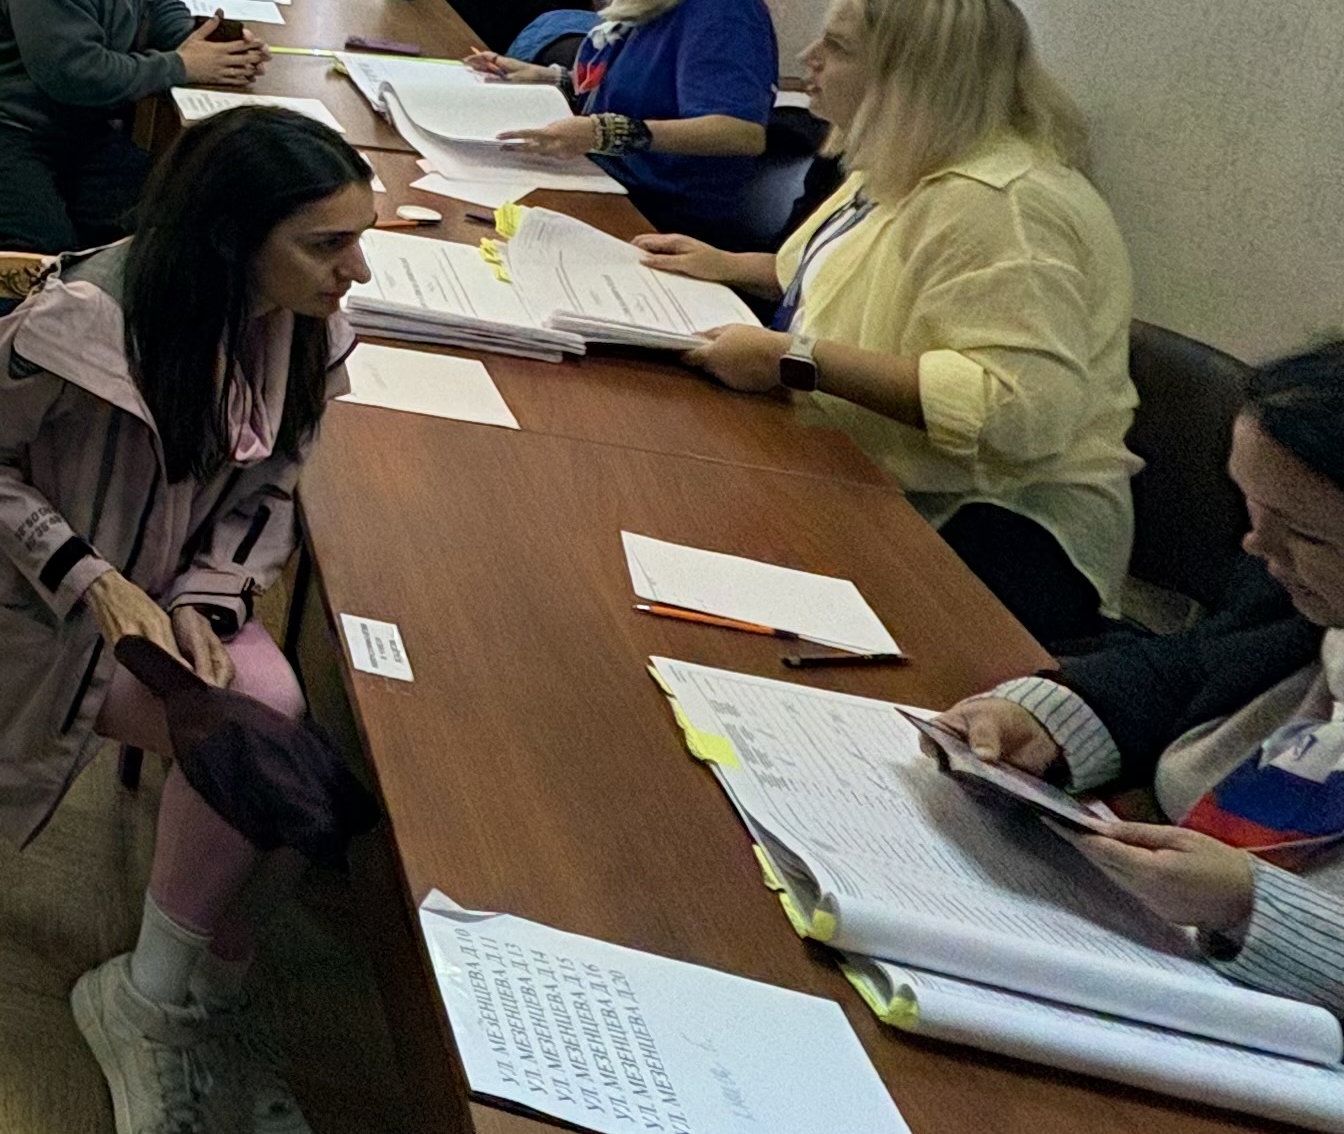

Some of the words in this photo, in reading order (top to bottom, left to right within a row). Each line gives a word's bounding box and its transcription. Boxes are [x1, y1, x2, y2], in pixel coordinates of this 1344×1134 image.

[466, 962, 510, 1056] МЕЗЕНЦЕВА
[492, 969, 538, 1065] МЕЗЕНЦЕВА
[517, 977, 565, 1074] МЕЗЕНЦЕВА
[544, 984, 594, 1083] МЕЗЕНЦЕВА
[570, 992, 623, 1092] МЕЗЕНЦЕВА
[597, 999, 653, 1100] МЕЗЕНЦЕВА
[624, 1006, 682, 1108] МЕЗЕНЦЕВА
